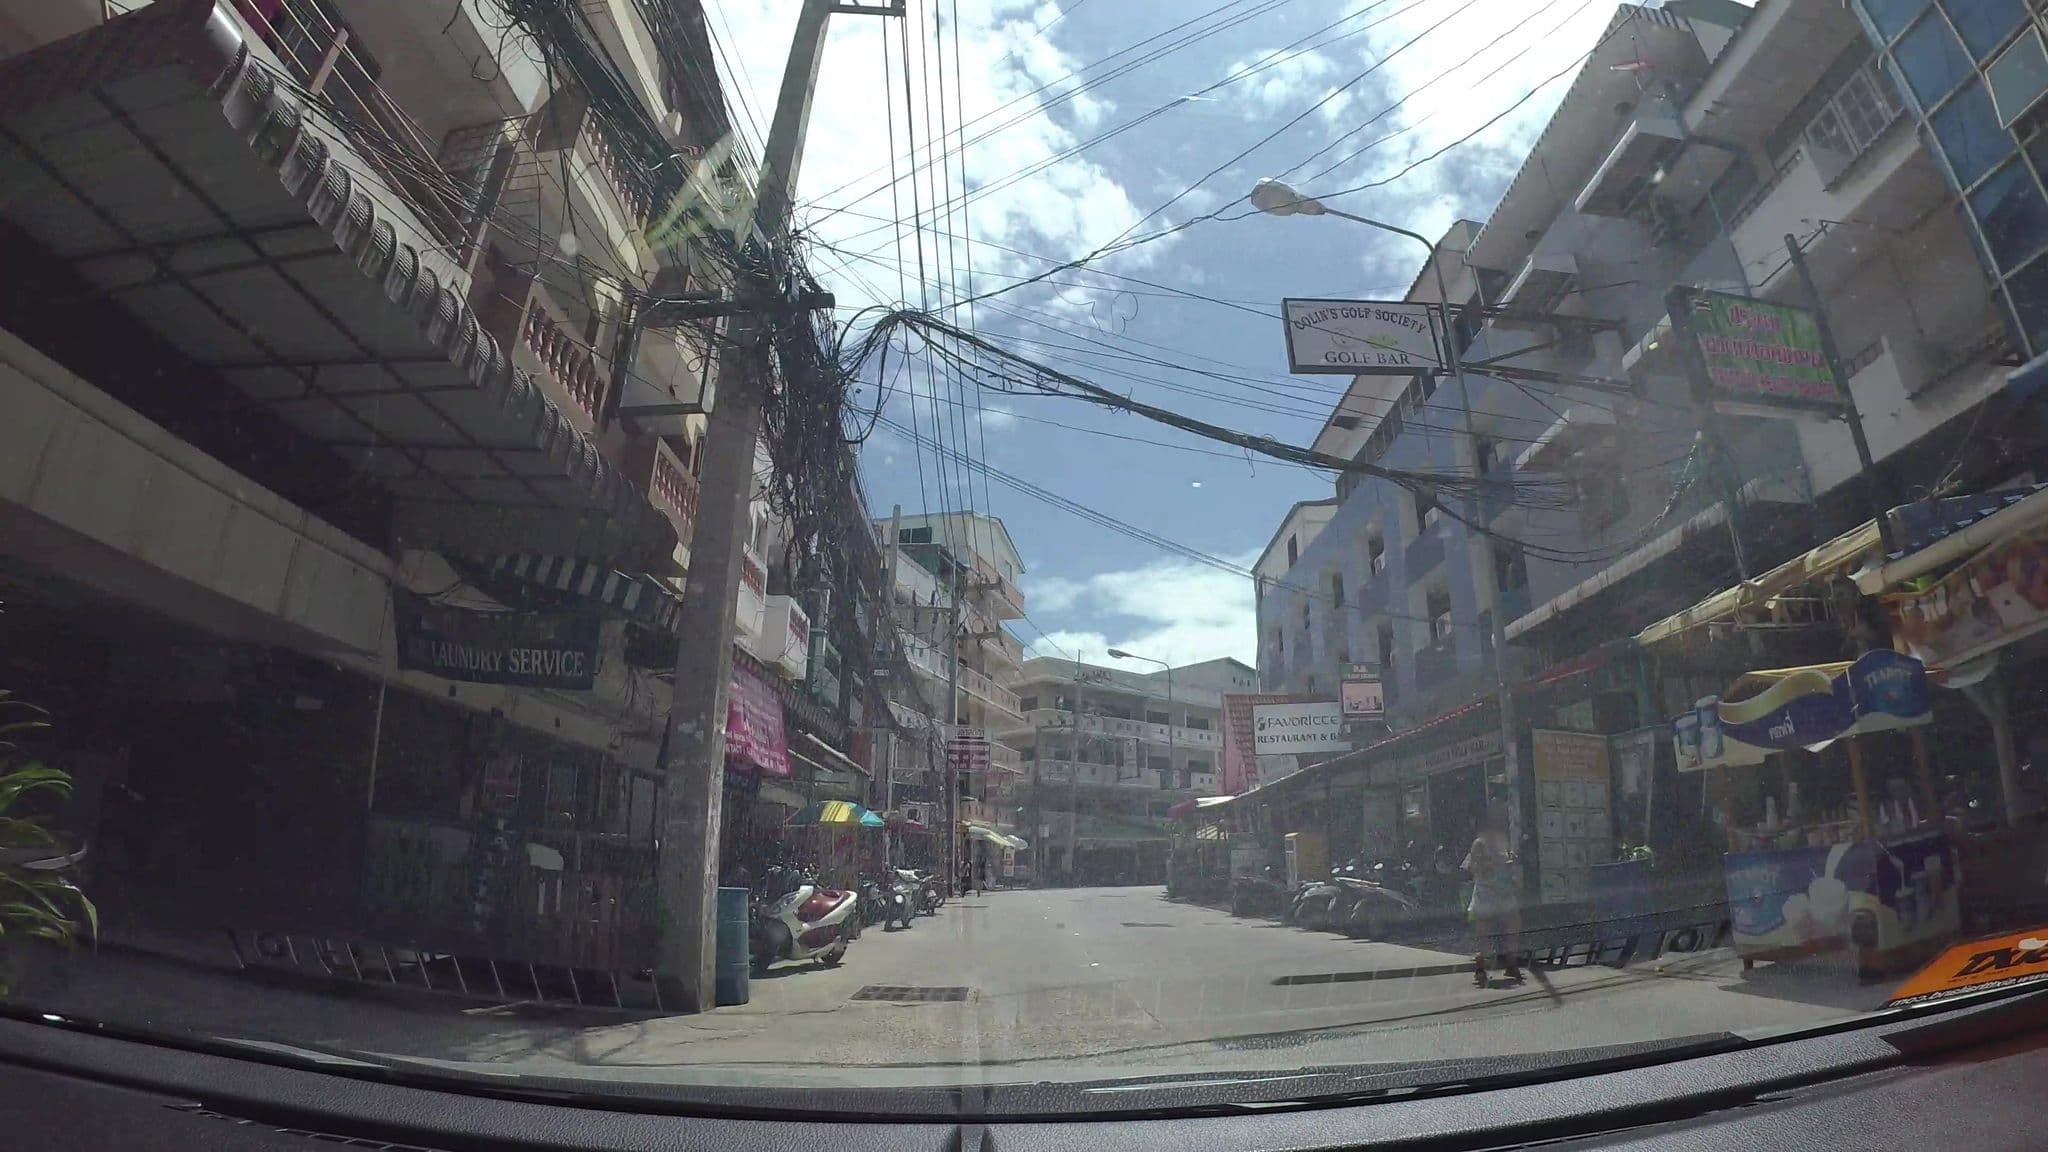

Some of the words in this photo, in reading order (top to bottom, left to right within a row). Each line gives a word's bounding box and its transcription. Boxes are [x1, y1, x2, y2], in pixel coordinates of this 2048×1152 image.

[1341, 307, 1370, 320] GOLF
[1375, 309, 1427, 334] SOCIETY
[1325, 350, 1370, 364] GOLF
[1376, 352, 1411, 365] BAR
[431, 641, 501, 673] LAUNDRY
[508, 648, 585, 676] SERVICE
[1257, 733, 1317, 744] RESTAURANT
[1320, 733, 1328, 742] &
